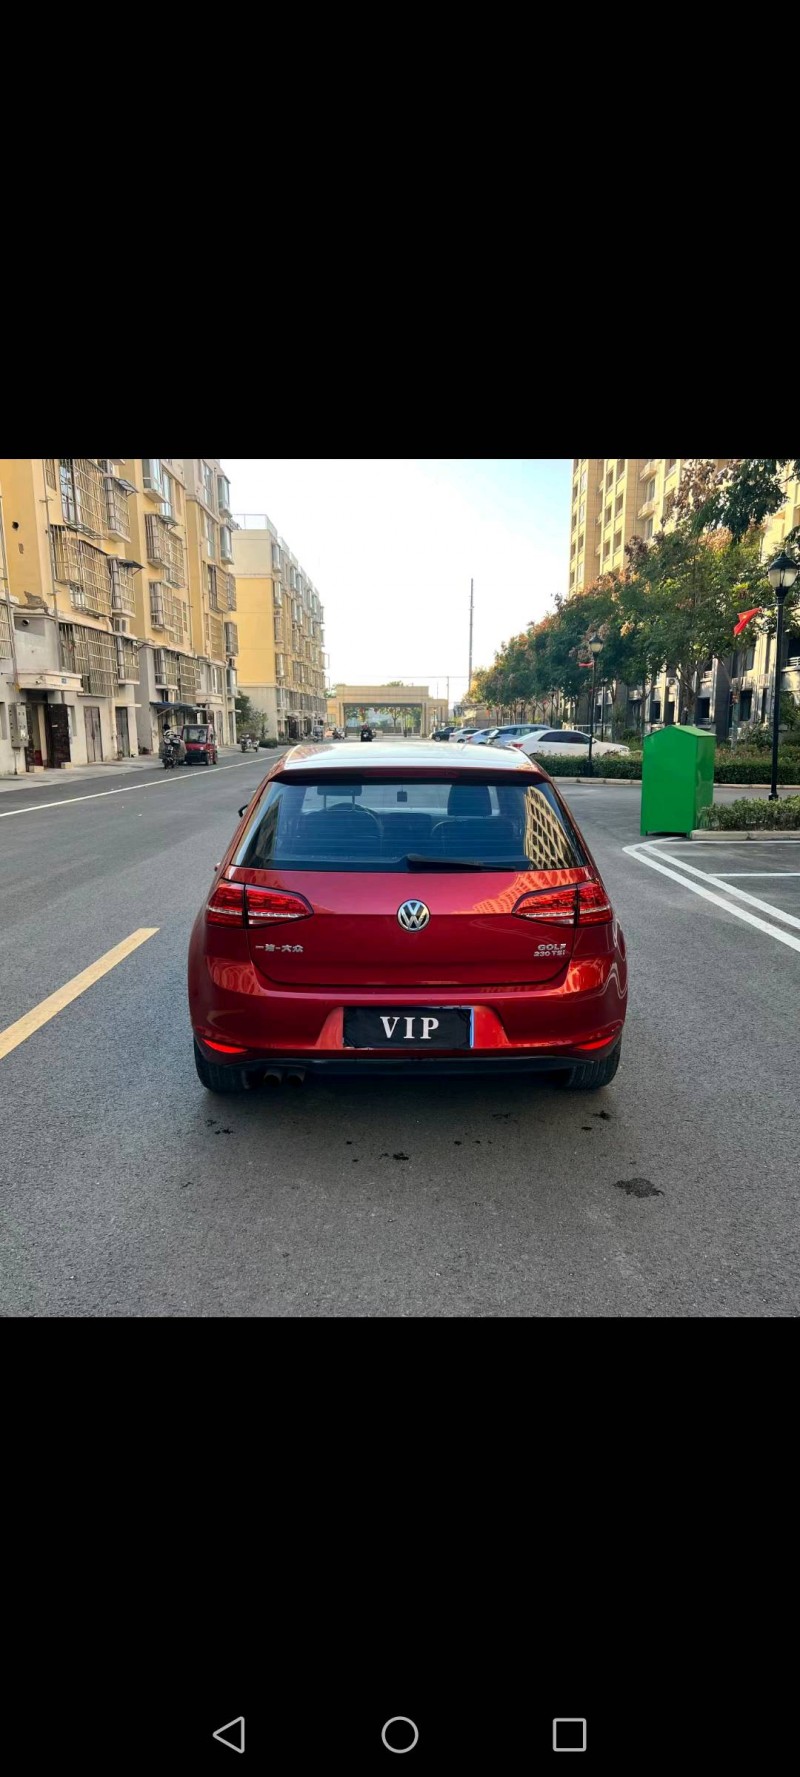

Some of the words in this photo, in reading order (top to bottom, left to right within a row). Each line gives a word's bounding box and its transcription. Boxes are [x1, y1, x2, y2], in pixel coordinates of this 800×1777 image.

[399, 900, 429, 931] VW
[538, 943, 566, 951] GOLF
[380, 1016, 440, 1039] VIP
